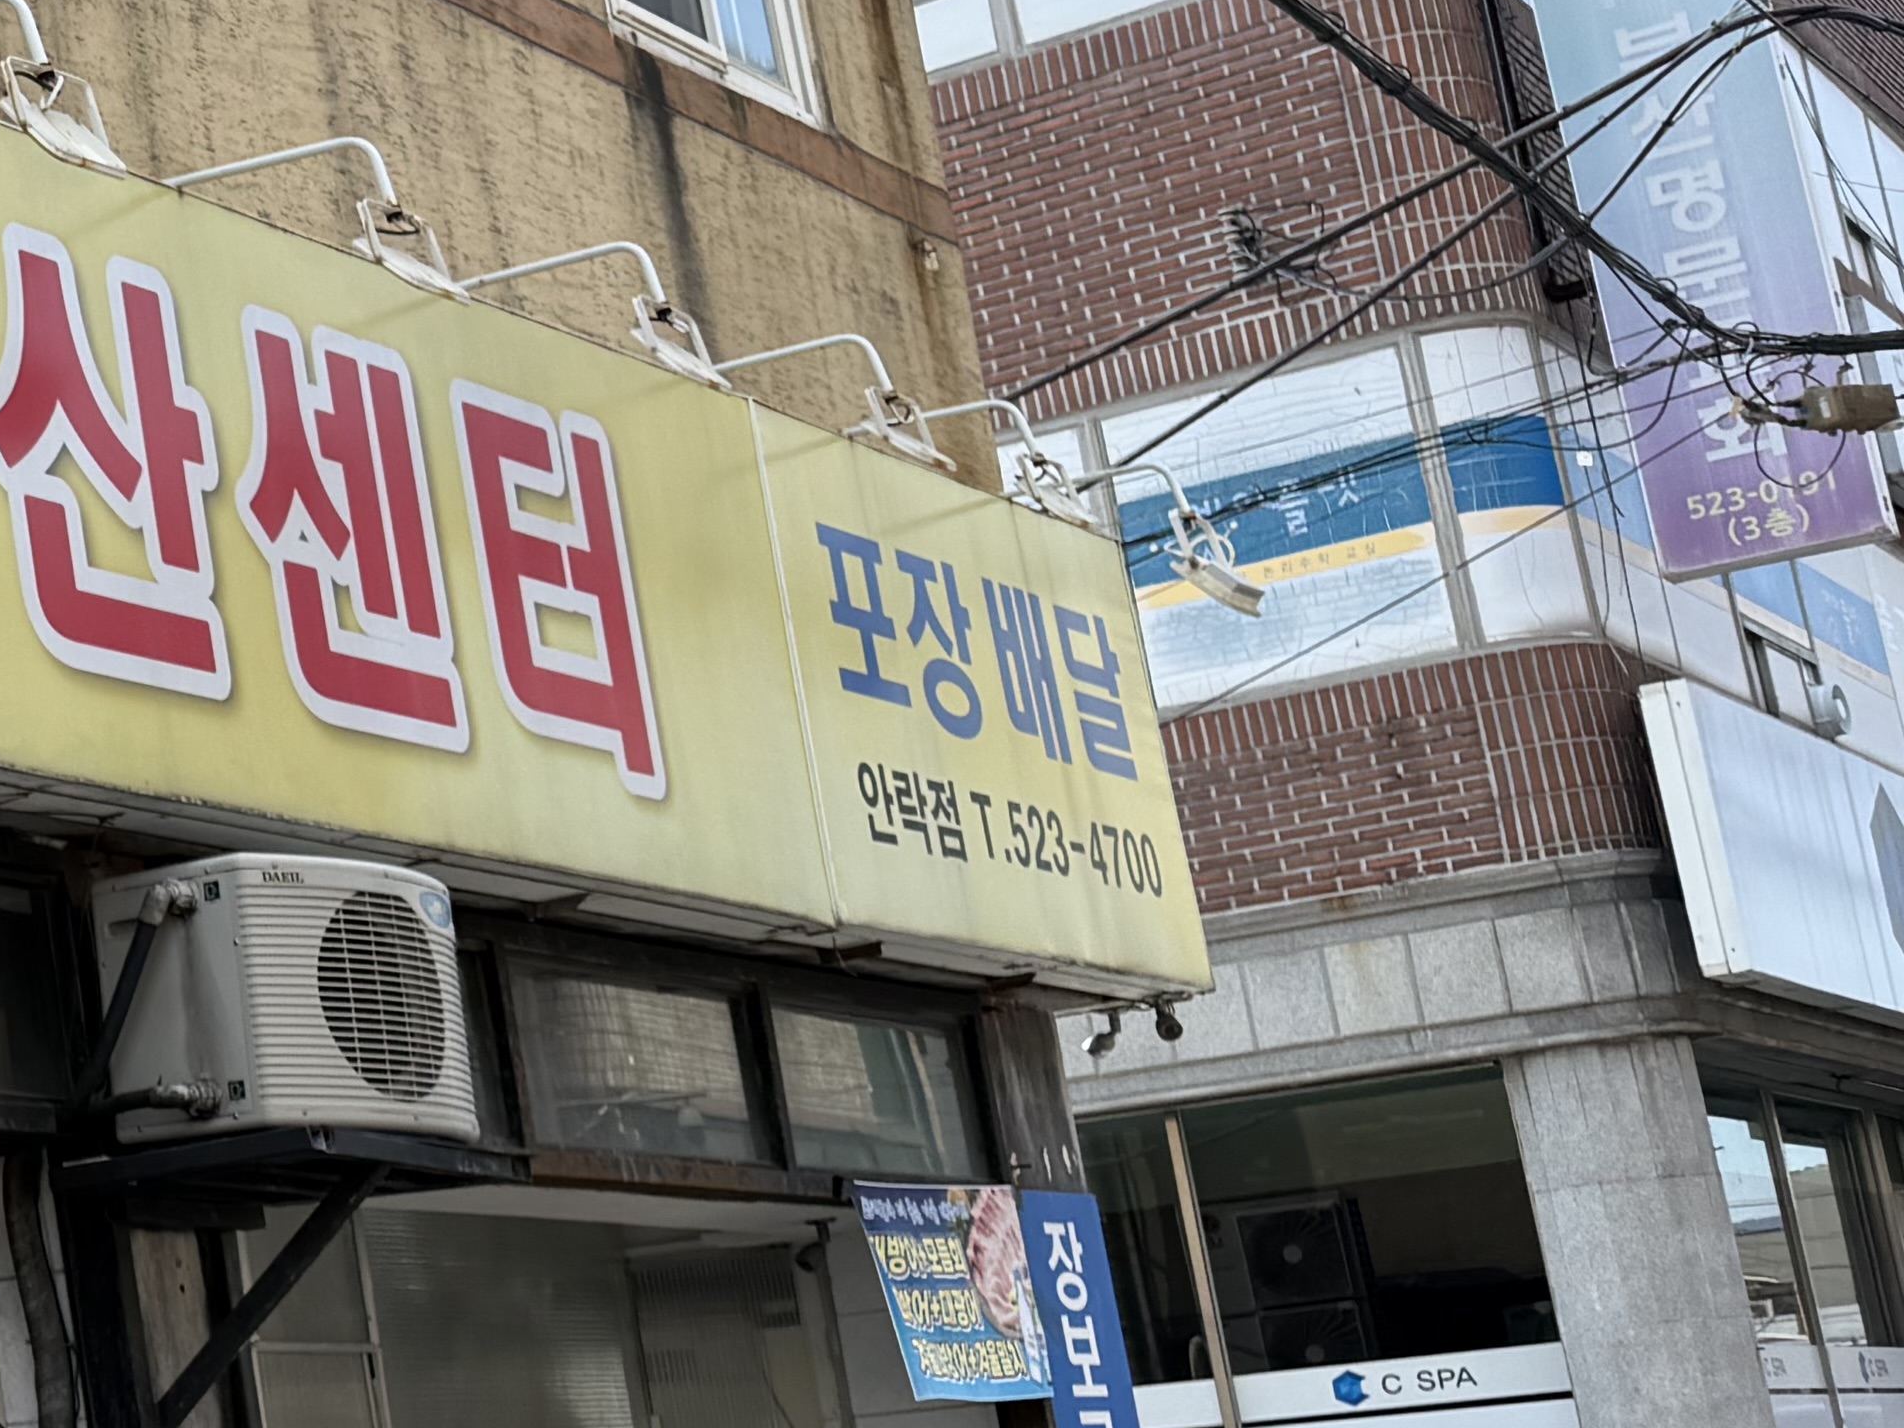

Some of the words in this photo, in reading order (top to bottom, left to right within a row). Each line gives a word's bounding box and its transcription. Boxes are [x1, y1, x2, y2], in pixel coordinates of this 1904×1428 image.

[857, 762, 968, 863] 안락점
[1381, 1374, 1403, 1395] C
[1417, 1367, 1478, 1393] SPA
